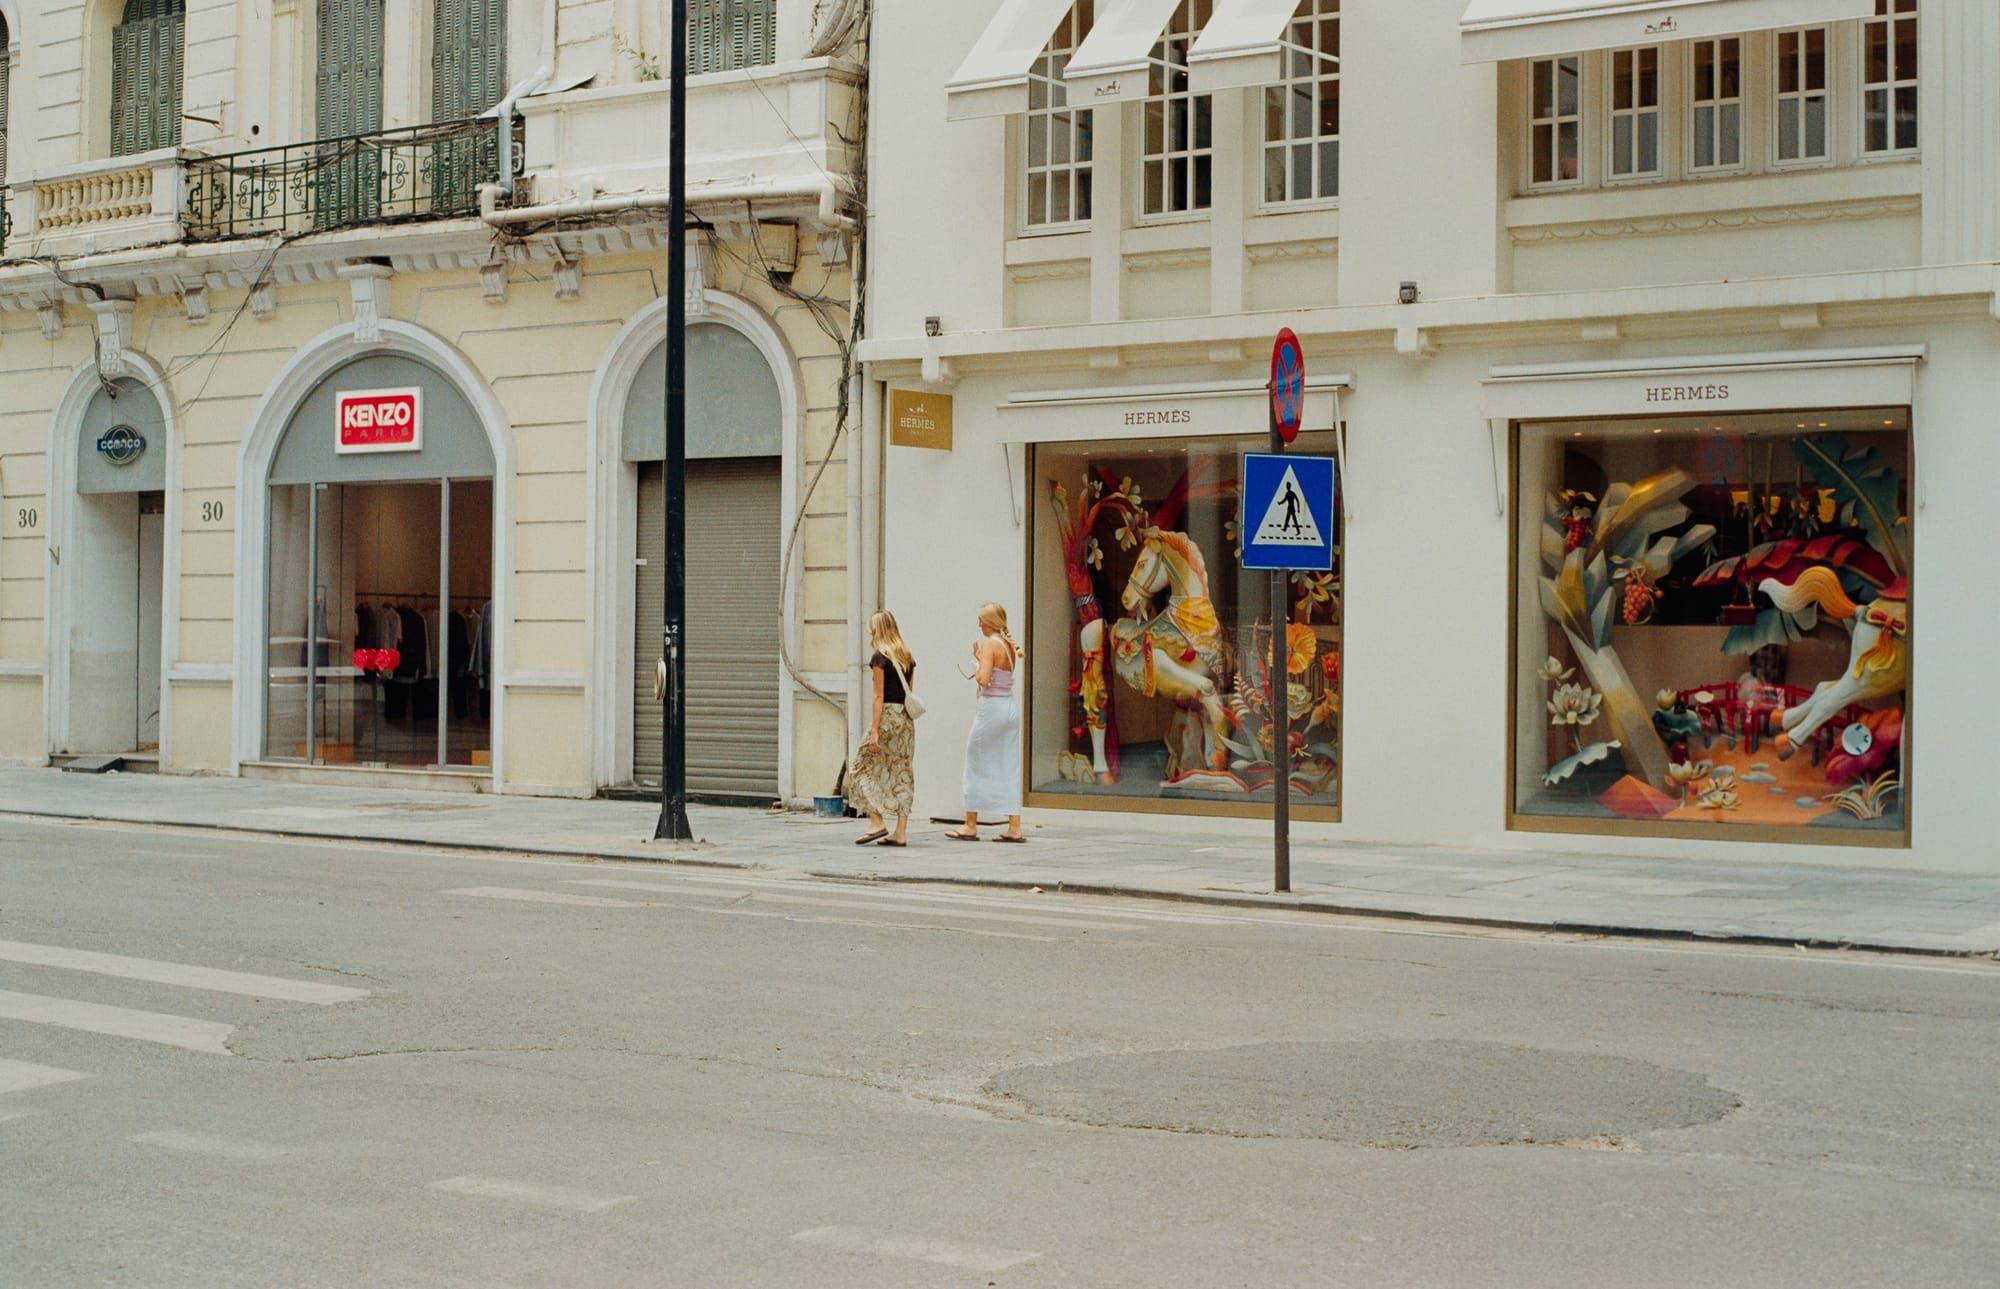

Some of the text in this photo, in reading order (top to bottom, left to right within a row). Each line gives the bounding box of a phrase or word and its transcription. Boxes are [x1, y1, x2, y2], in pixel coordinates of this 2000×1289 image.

[1646, 384, 1729, 402] HERMÈS
[344, 402, 411, 428] KENZO
[1124, 409, 1191, 425] HERMÈS
[344, 427, 409, 438] PARIS
[18, 508, 37, 528] 30
[202, 501, 223, 521] 30
